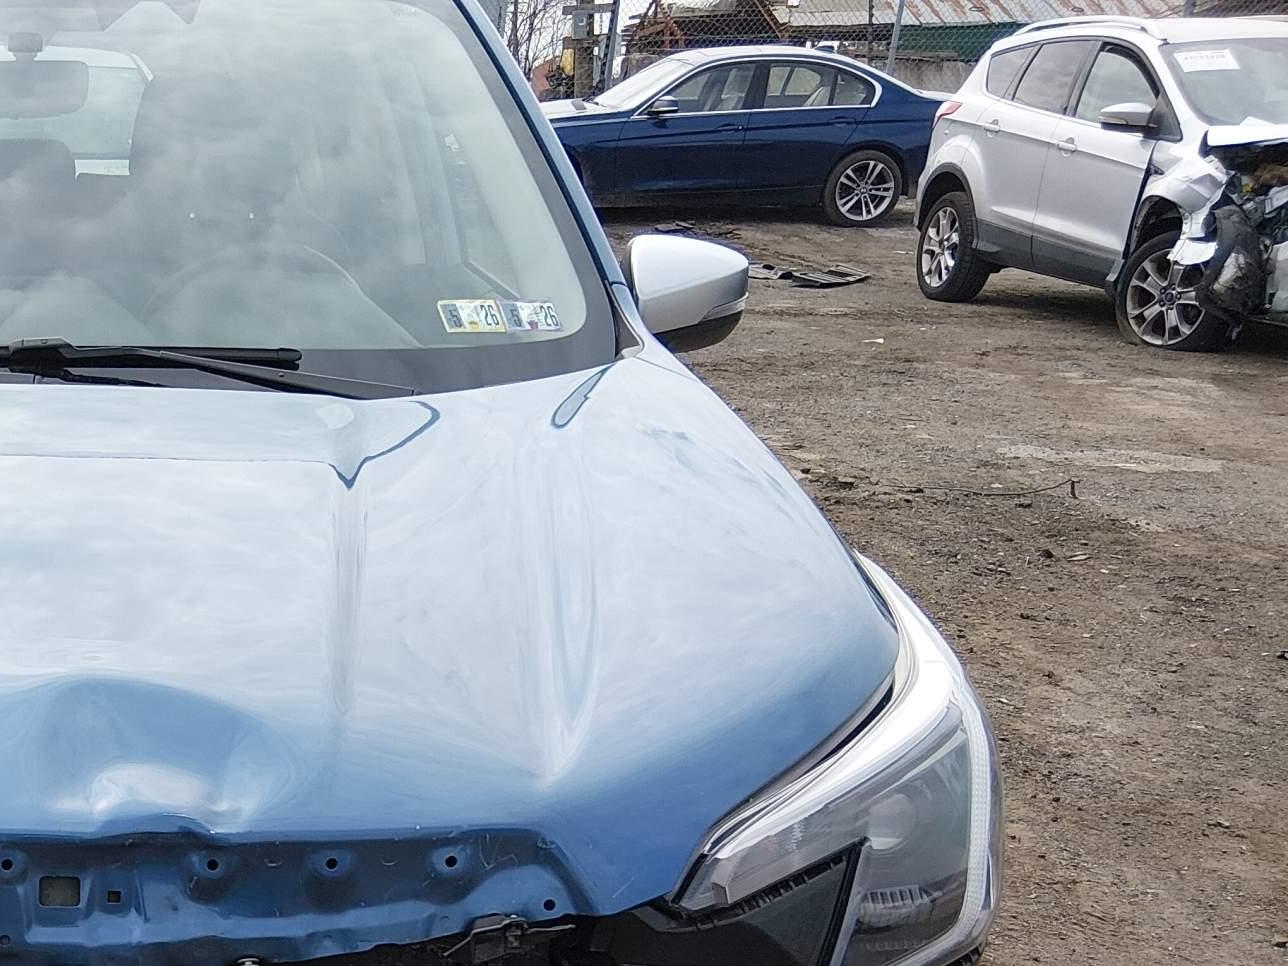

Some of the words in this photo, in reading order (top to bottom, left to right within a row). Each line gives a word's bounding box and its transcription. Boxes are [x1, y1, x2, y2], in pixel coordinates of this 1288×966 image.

[449, 308, 463, 328] 5
[479, 304, 500, 327] 26
[510, 309, 523, 328] 5
[539, 305, 560, 327] 26
